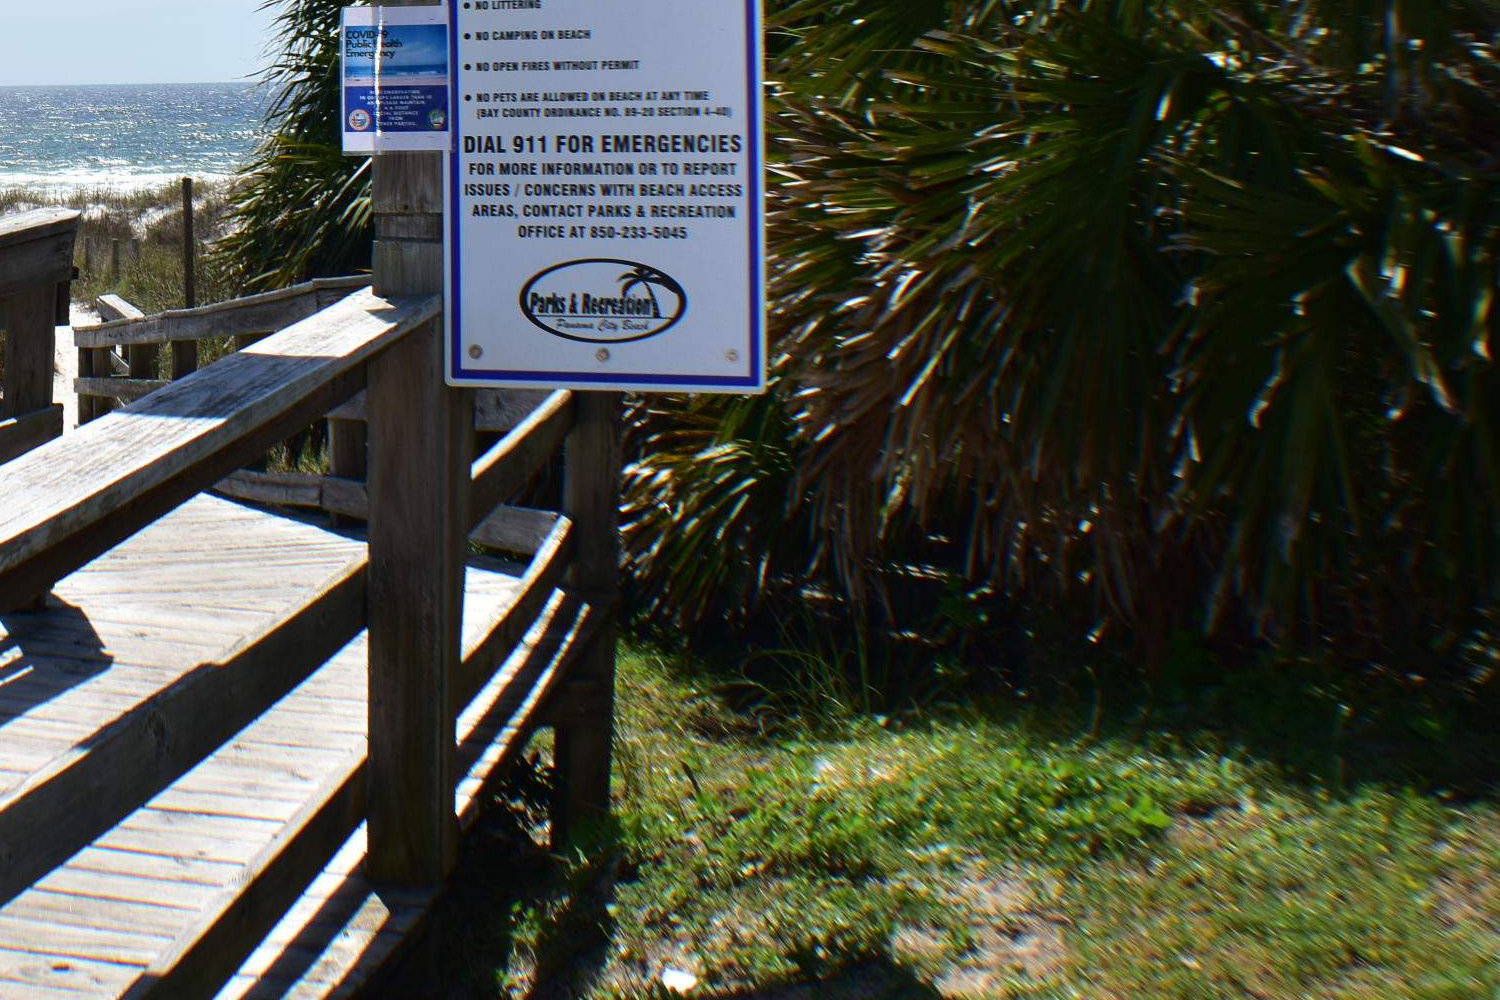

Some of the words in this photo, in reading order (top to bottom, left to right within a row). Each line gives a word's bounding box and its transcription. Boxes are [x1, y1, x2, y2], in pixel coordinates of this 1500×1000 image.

[475, 1, 489, 10] NO
[492, 0, 542, 9] LITTERING
[346, 31, 388, 39] COVID-9
[475, 31, 489, 41] NO
[492, 31, 537, 40] CAMPING
[541, 30, 554, 40] ON
[557, 30, 591, 39] BEACH
[346, 40, 372, 48] Public
[346, 50, 395, 59] Emergncy
[476, 62, 489, 72] NO
[493, 62, 518, 71] OPEN
[522, 61, 550, 71] FIRES
[553, 61, 598, 70] WITHOUT
[601, 60, 640, 70] PERMIT
[476, 93, 490, 103] NO
[493, 93, 517, 103] PETS
[520, 93, 539, 102] ARE
[542, 92, 589, 102] ALLOWED
[592, 92, 605, 102] ON
[609, 92, 642, 101] BEACH
[645, 92, 658, 101] AT
[661, 91, 681, 101] ANY
[683, 91, 709, 101] TIME
[464, 135, 506, 154] DIAL
[513, 135, 547, 154] 911
[556, 135, 594, 153] FOR
[602, 135, 741, 153] EMERGENCIES
[469, 163, 494, 176] FOR
[499, 163, 537, 176] MORE
[542, 163, 634, 176] INFORMATION
[638, 163, 657, 176] OR
[661, 163, 678, 176] TO
[683, 163, 737, 176] REPORT
[465, 183, 510, 196] ISSUES
[524, 184, 595, 196] CONCERNS
[600, 184, 634, 196] WITH
[639, 184, 684, 196] BEACH
[688, 184, 742, 197] ACCESS
[472, 204, 518, 218] AREAS,
[523, 205, 583, 218] CONTACT
[588, 205, 632, 218] PARKS
[636, 205, 646, 218] &
[651, 206, 736, 218] RECREATION
[518, 226, 565, 239] OFFICE
[569, 226, 586, 239] AT
[590, 227, 688, 239] 850-233-5045
[531, 292, 566, 313] Parks
[569, 293, 578, 313] &
[582, 293, 650, 315] Recreation
